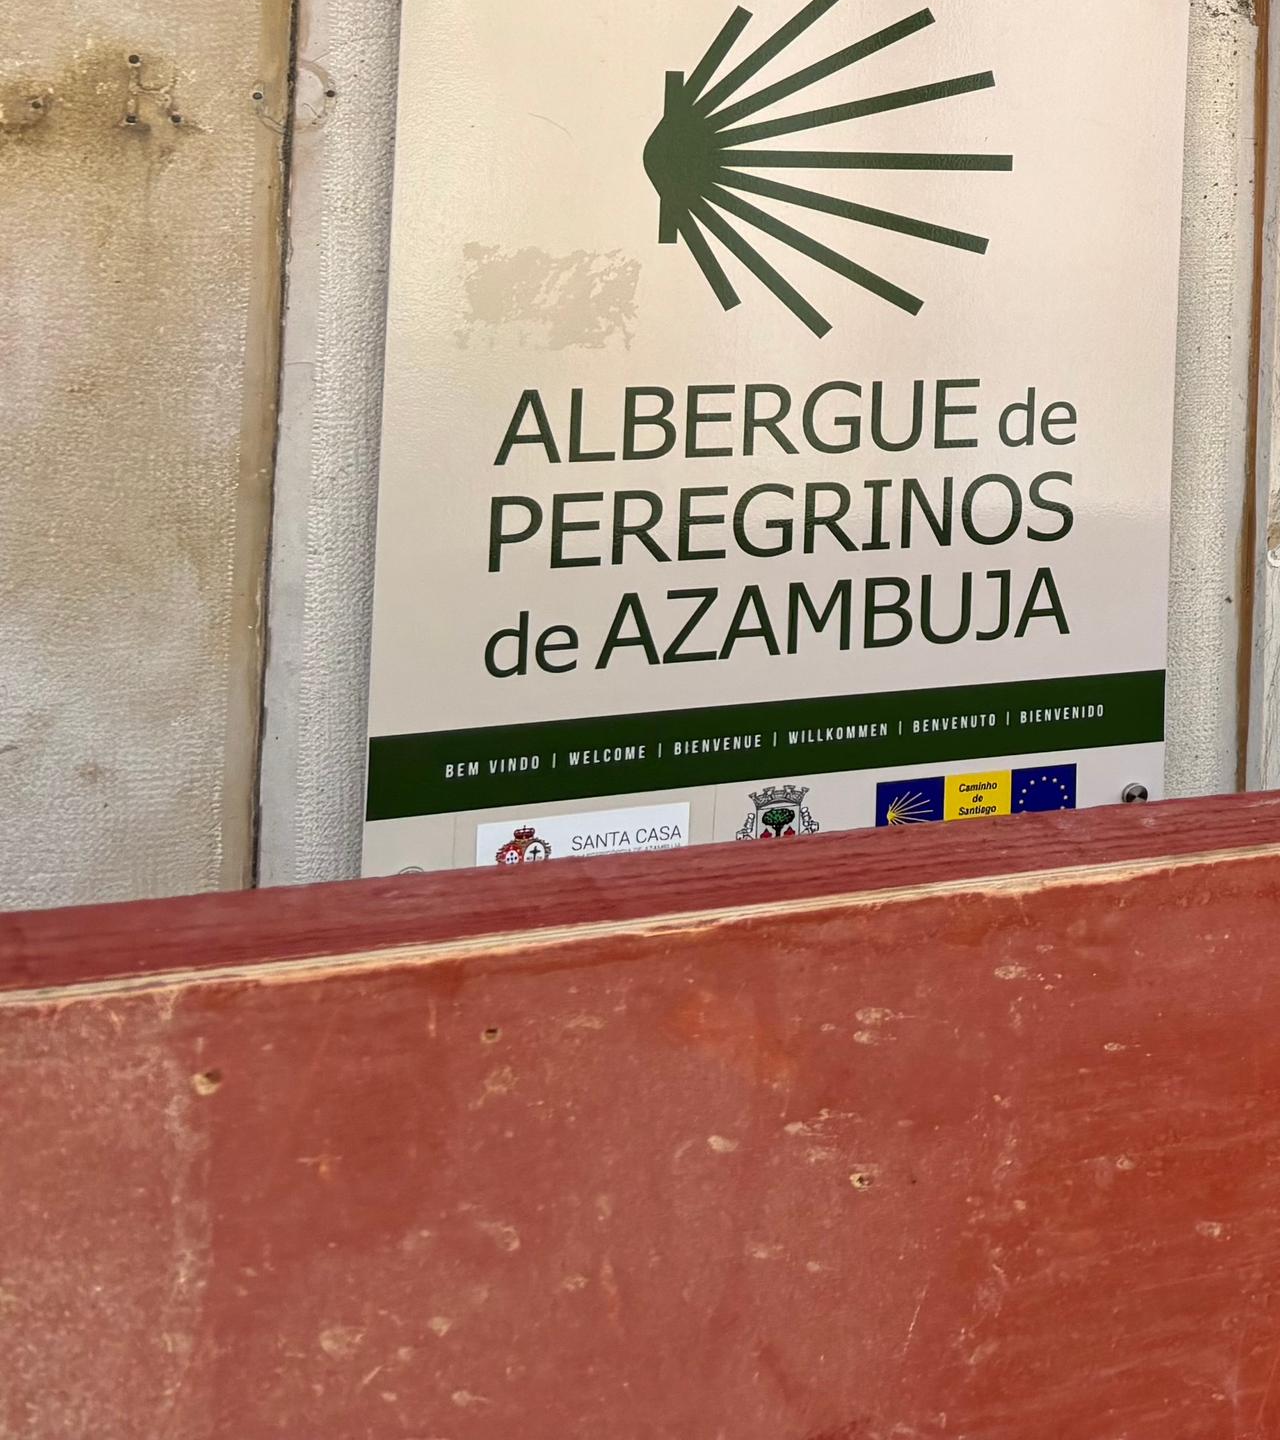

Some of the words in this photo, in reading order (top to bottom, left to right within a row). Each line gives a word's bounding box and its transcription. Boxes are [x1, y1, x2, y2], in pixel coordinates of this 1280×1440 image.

[493, 378, 979, 466] ALBERGUE
[1000, 388, 1077, 446] de
[488, 471, 1074, 573] PEREGRINOS
[484, 611, 579, 678] de
[595, 567, 1071, 669] AZAMBUJA
[445, 761, 479, 778] BEM
[489, 756, 540, 774] VINDO
[569, 745, 647, 766] WELCOME
[674, 734, 762, 756] BIENVENUE
[788, 723, 888, 745] WILLKOMMEN
[913, 713, 997, 733] BENVENUTO
[1020, 704, 1104, 724] BIENVENIDO
[958, 781, 997, 793] Caminho
[958, 804, 997, 816] Santiago
[972, 794, 984, 803] de
[571, 831, 631, 851] SANTA
[636, 825, 682, 844] CASA
